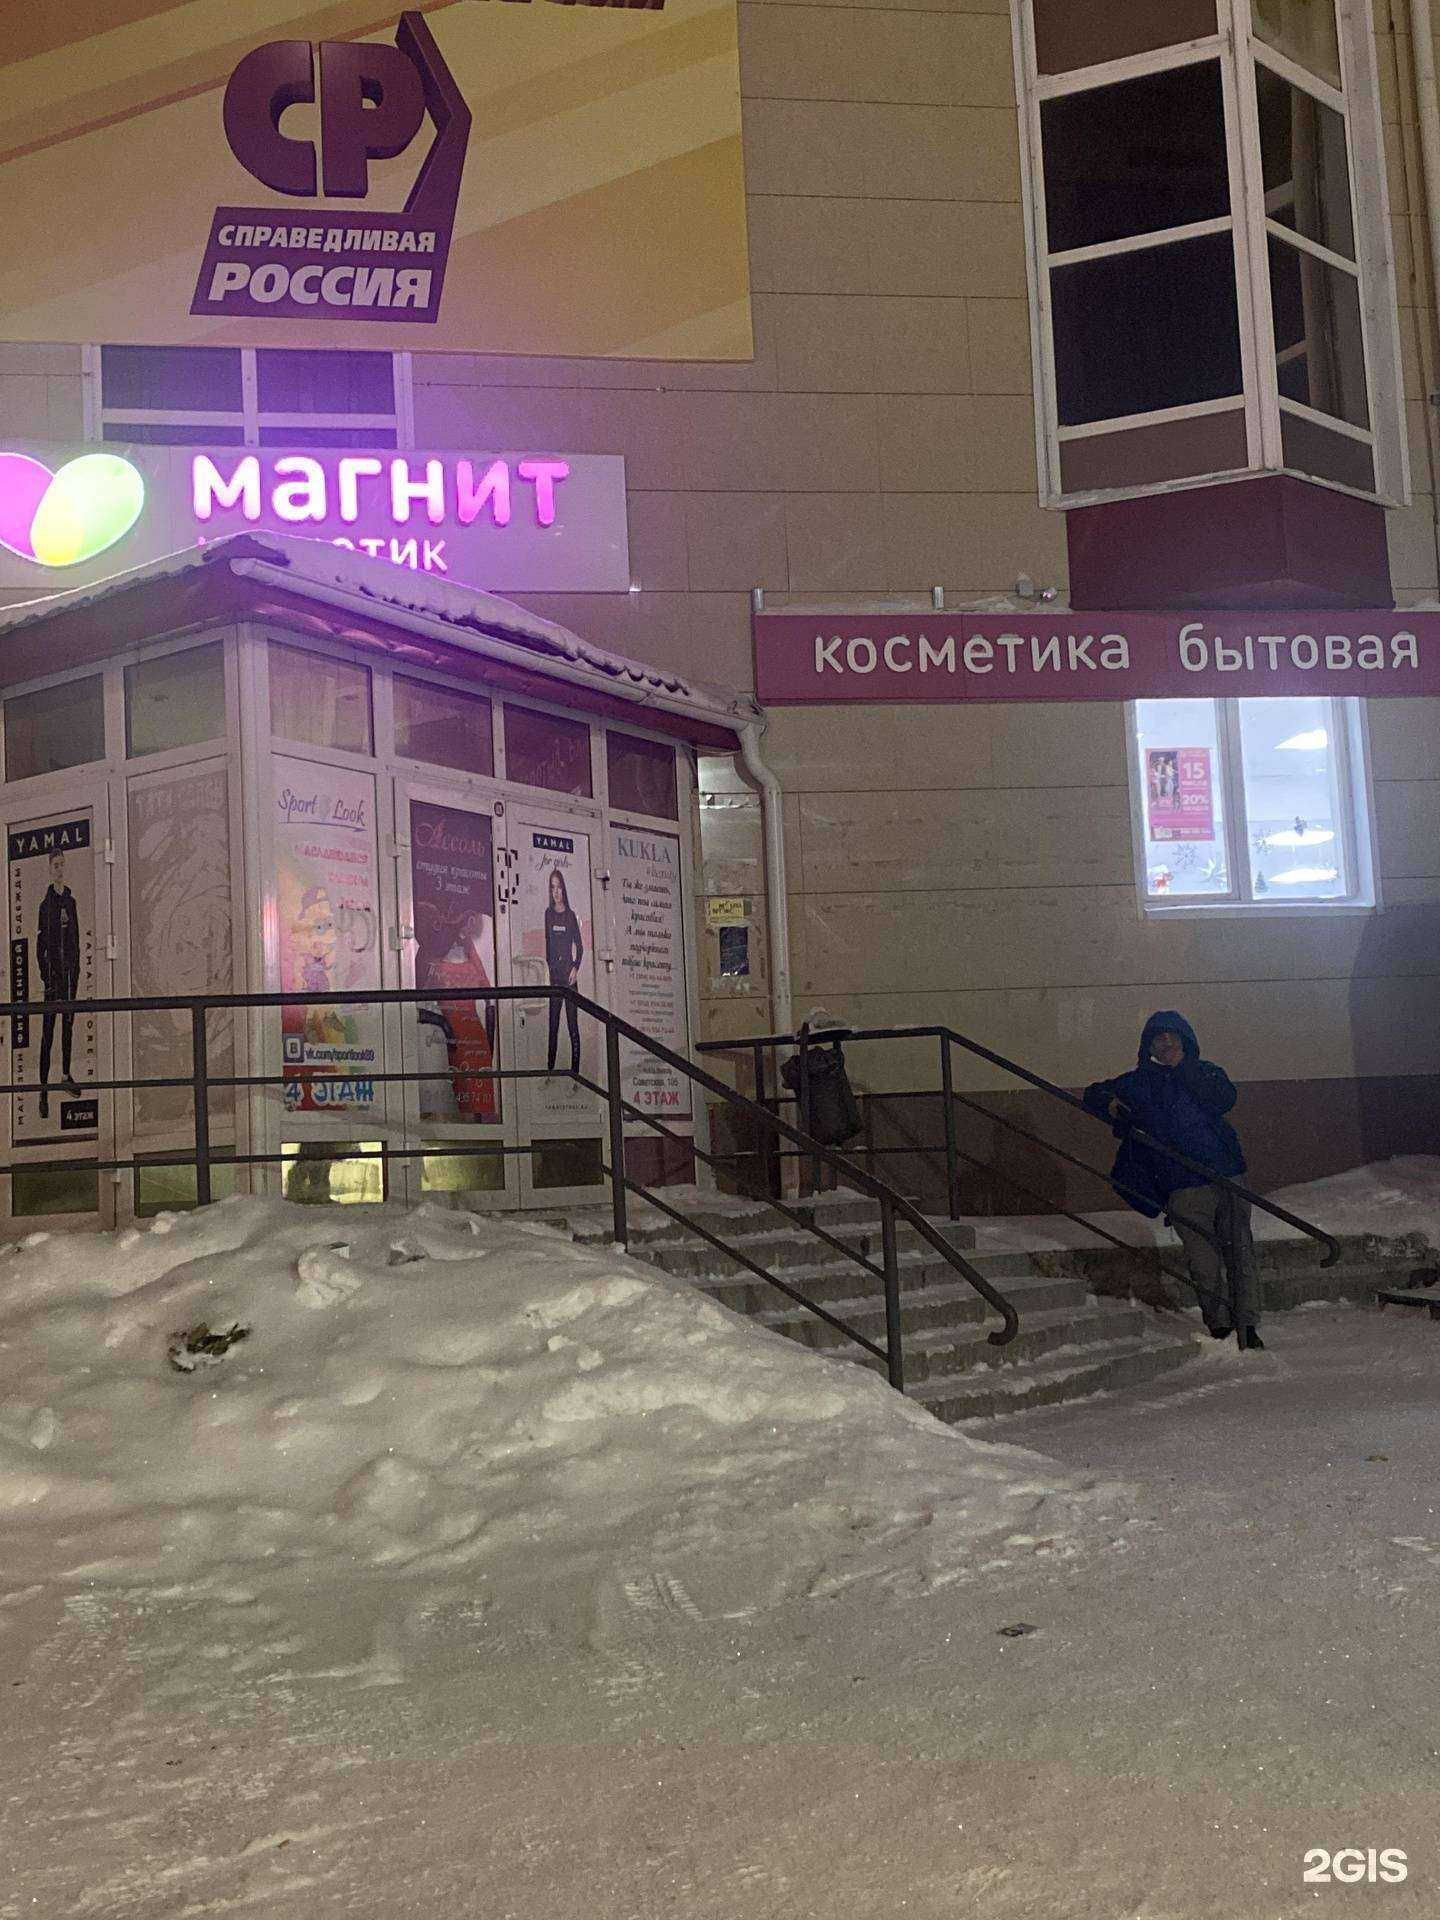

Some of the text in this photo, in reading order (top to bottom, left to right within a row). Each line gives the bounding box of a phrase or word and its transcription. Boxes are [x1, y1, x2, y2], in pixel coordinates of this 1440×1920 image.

[223, 40, 426, 199] СР
[218, 225, 436, 253] СПРАВЕДЛИВАЯ
[208, 262, 432, 308] РОССИЯ
[814, 623, 1420, 674] косметика бытовая
[1183, 762, 1205, 780] 15
[278, 788, 366, 827] Sport Look
[15, 827, 83, 854] YAMAL
[536, 836, 571, 850] YAMAL
[617, 837, 672, 864] KUKLA
[633, 1091, 680, 1106] 4 ЭТАЖ
